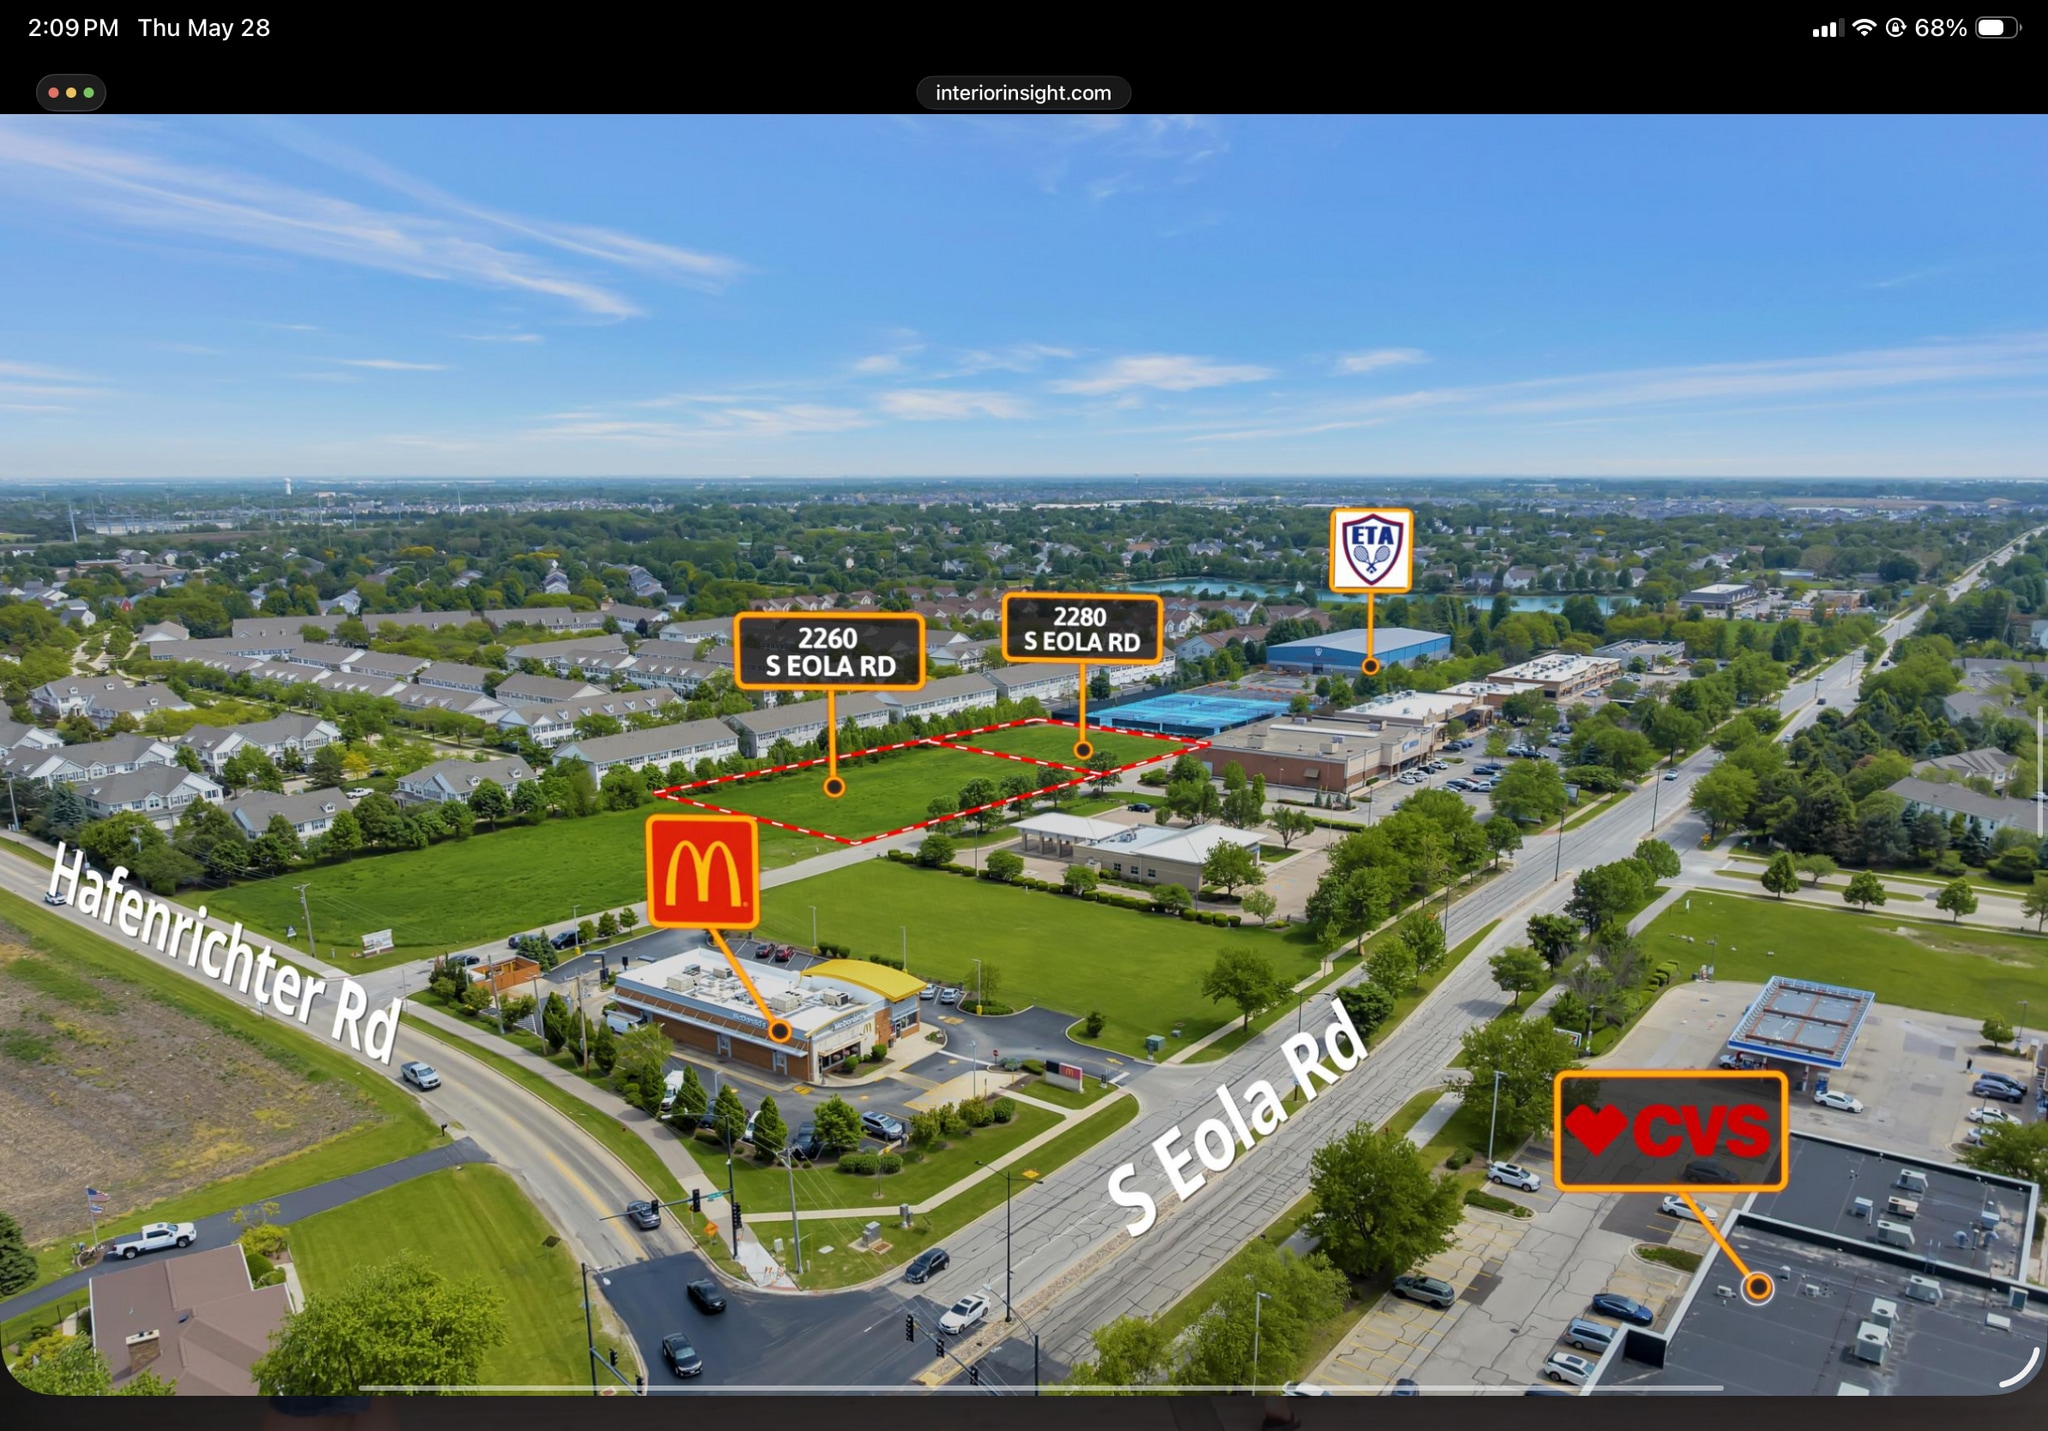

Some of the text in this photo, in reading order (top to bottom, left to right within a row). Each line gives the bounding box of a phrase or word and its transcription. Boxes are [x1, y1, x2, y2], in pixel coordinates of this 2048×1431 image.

[28, 18, 119, 38] 2:09 PM
[137, 17, 270, 42] Thu May 28
[1885, 17, 1968, 39] 68%
[936, 83, 1112, 105] interiorinsight.com
